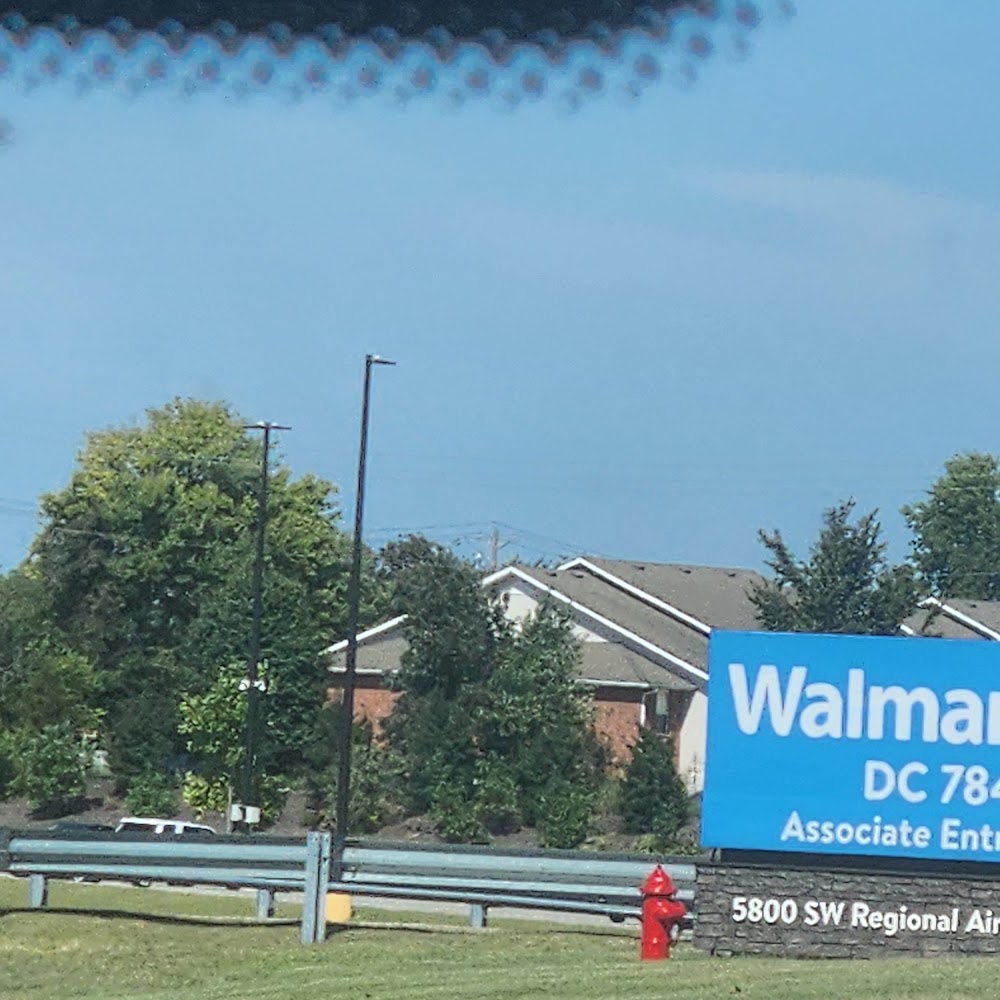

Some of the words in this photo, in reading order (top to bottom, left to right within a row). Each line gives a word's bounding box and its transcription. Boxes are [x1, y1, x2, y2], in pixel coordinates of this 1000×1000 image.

[864, 760, 928, 803] DC
[781, 811, 931, 848] Associate
[732, 897, 798, 924] 5800
[803, 901, 846, 926] SW
[851, 902, 960, 936] Regional
